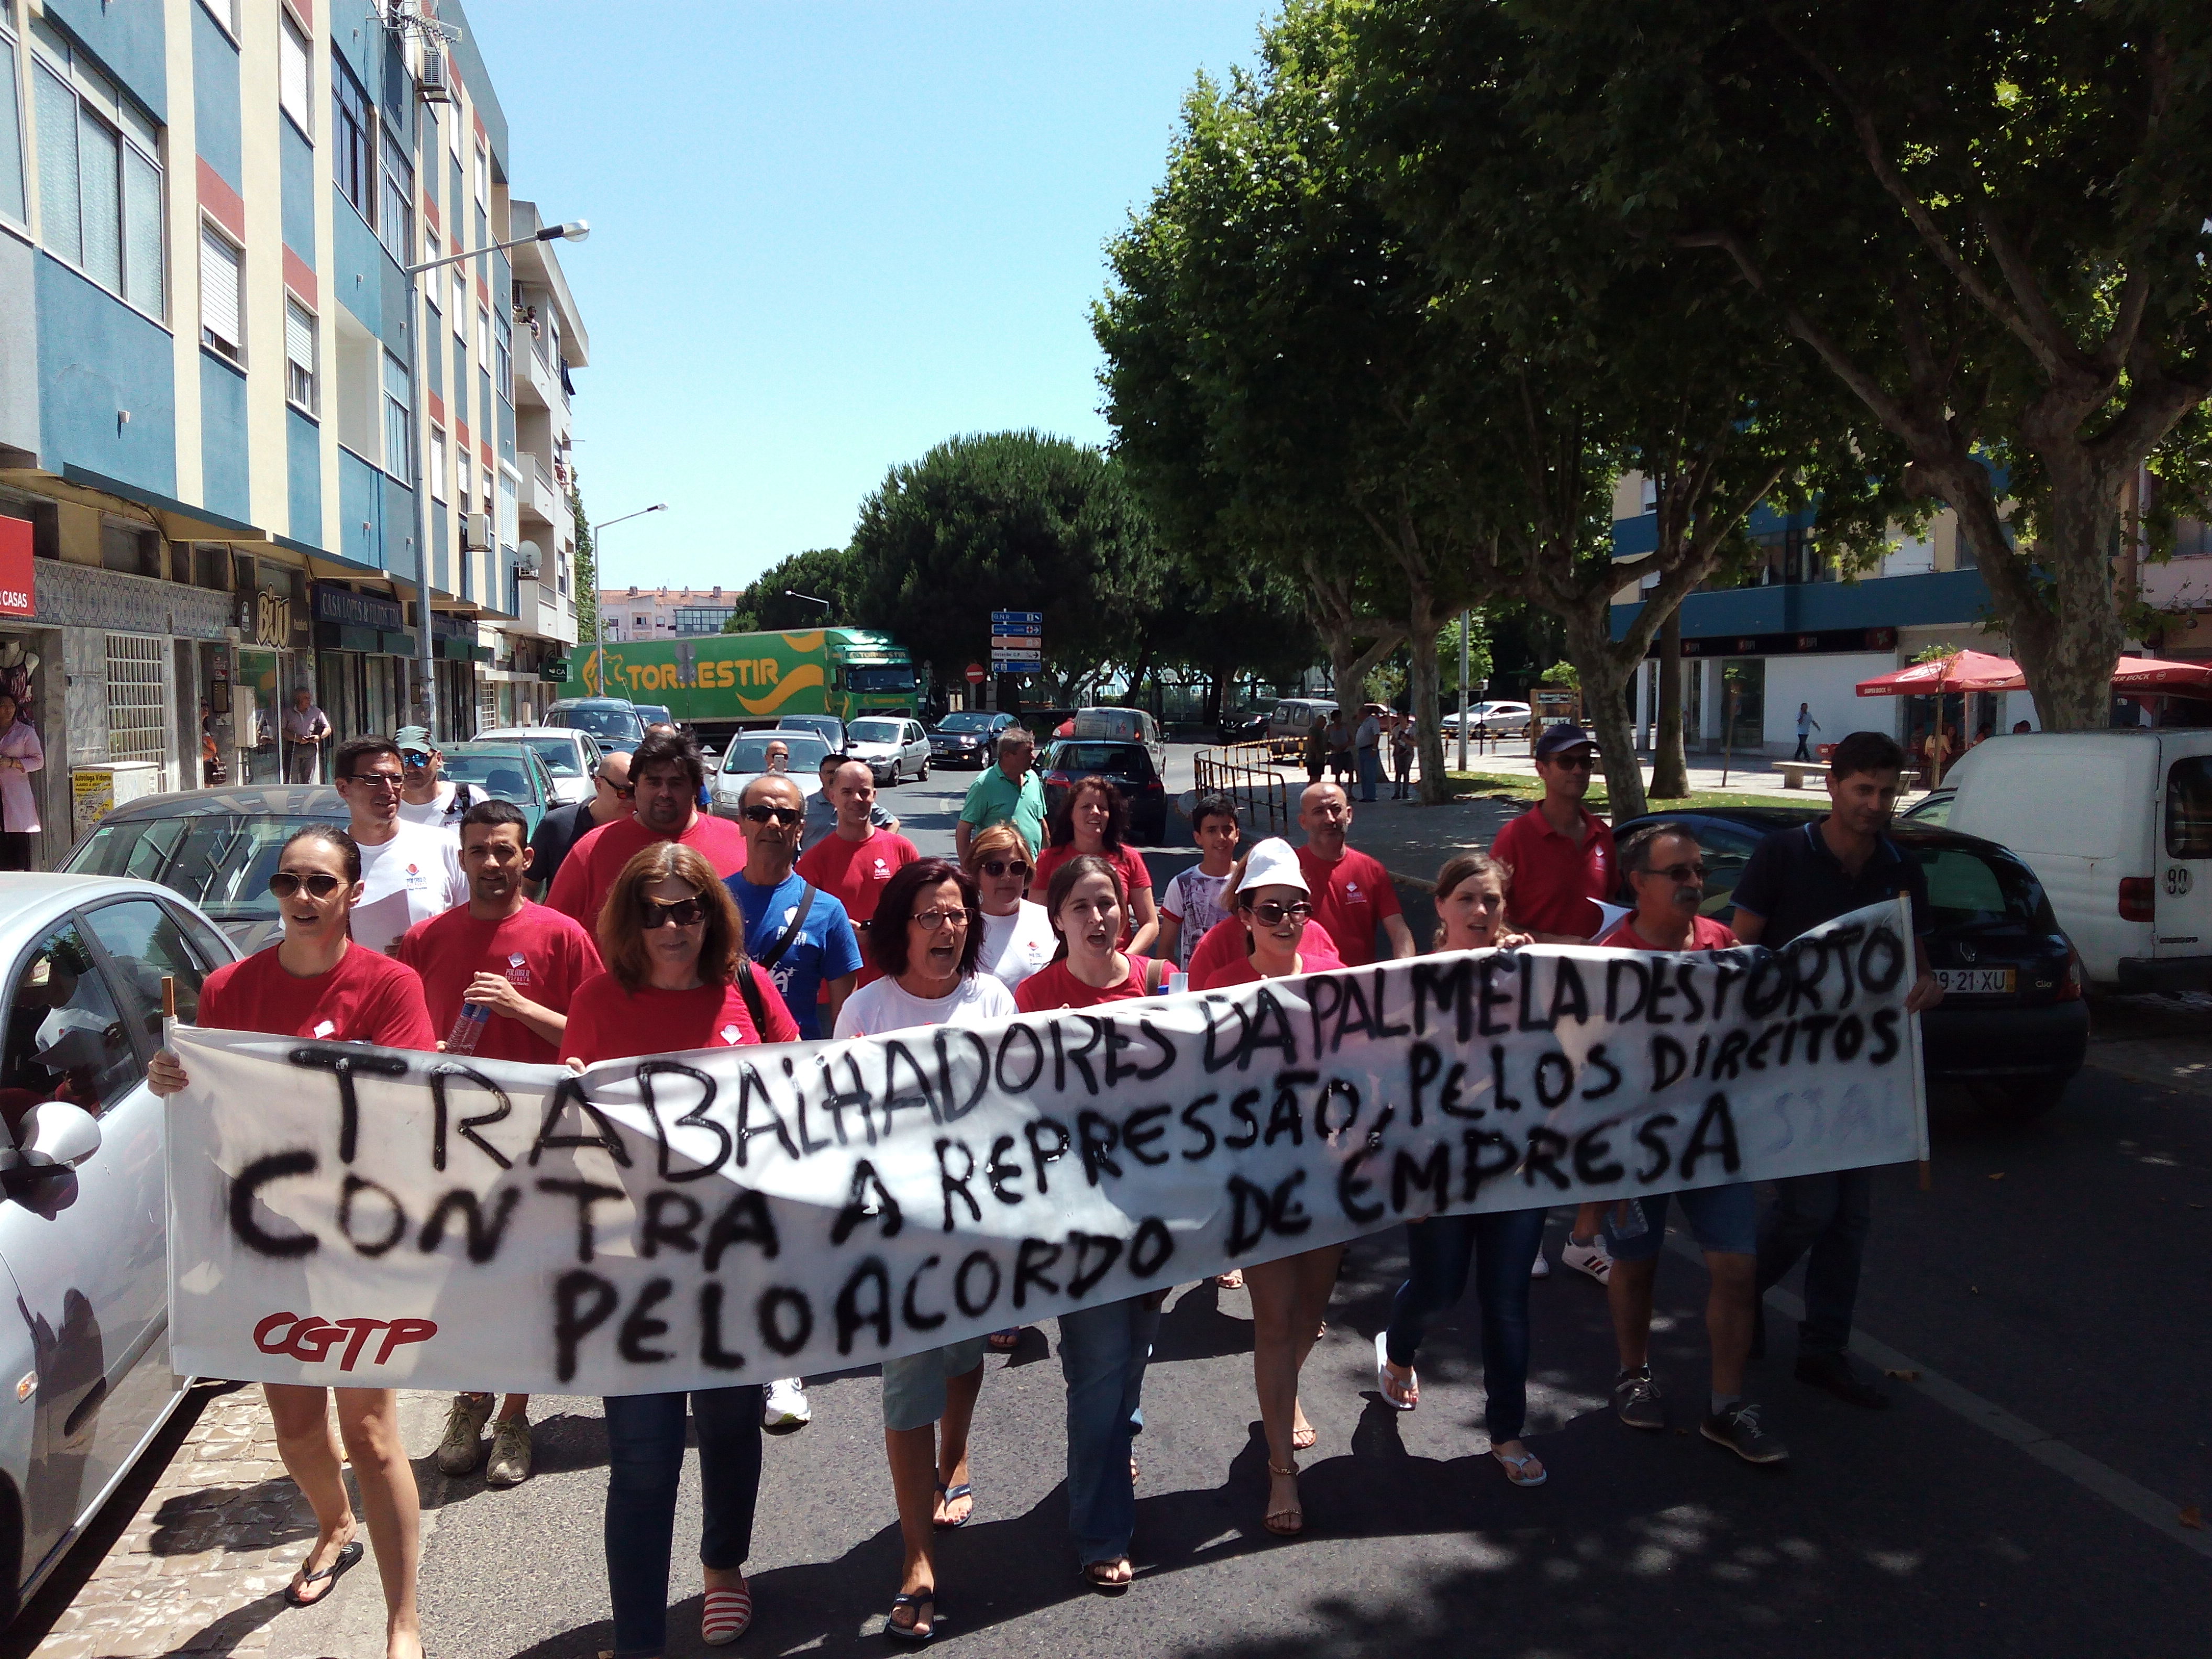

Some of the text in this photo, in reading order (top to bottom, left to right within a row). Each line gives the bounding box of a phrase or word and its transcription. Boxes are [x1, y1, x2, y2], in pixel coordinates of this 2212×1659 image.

[2, 591, 27, 608] CASAS
[322, 592, 341, 617] CASA
[1745, 640, 1755, 650] BPI
[1807, 637, 1818, 647] BPI
[626, 658, 779, 691] TORESTIR
[2035, 980, 2053, 988] Clio
[289, 924, 1905, 1182] TRABALHADORES DA PALMELA DESPORTO
[229, 1151, 779, 1271] CONTRA
[831, 1158, 905, 1247] A
[1410, 1044, 1623, 1126] PELOS
[1651, 1009, 1901, 1092] DIREITOS
[1226, 1169, 1311, 1259] DE
[1339, 1090, 1742, 1225] EMPRESA
[253, 1311, 438, 1371] CGTP
